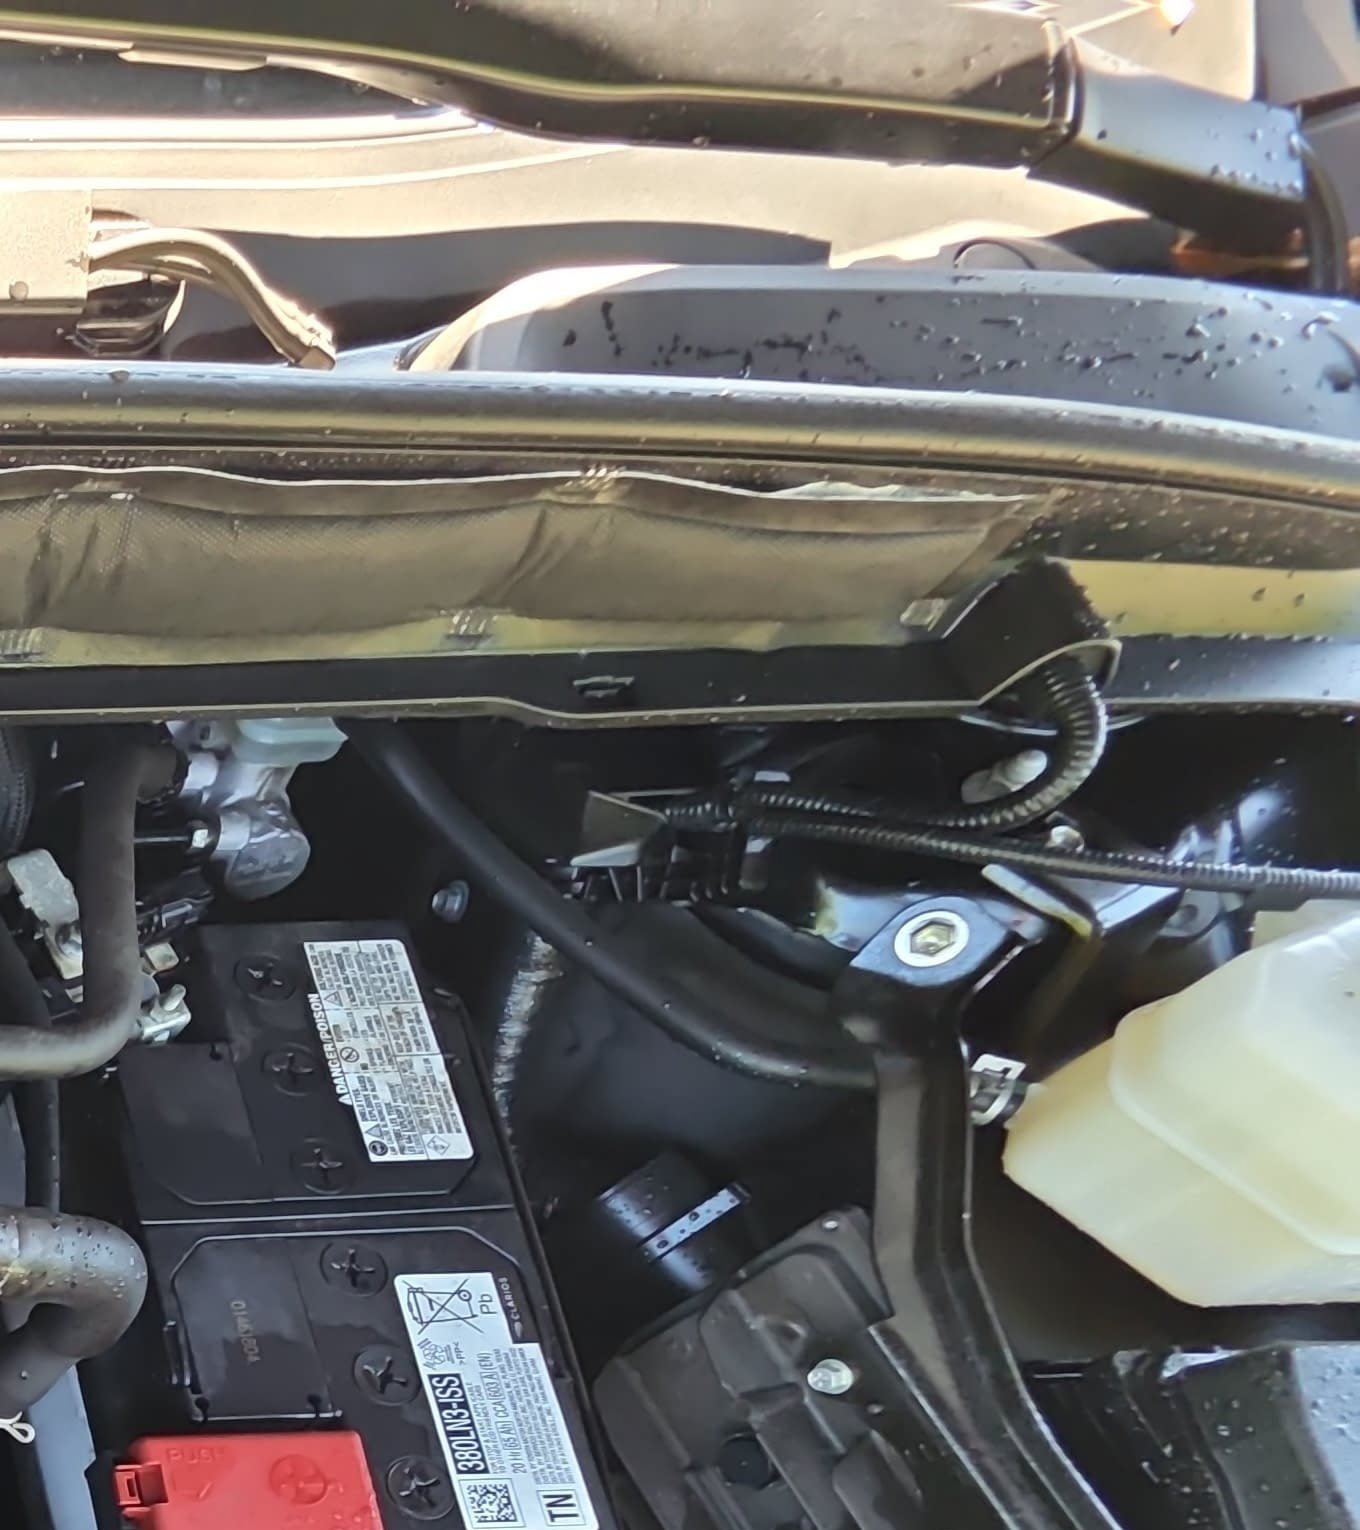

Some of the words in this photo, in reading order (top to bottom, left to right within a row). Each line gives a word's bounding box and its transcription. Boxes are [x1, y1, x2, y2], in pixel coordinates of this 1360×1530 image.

[307, 993, 348, 1095] DANGER/POISON
[475, 1293, 496, 1314] Pb
[498, 1276, 521, 1319] CLARIOS
[476, 1352, 495, 1370] (EN)
[485, 1382, 504, 1397] 603
[490, 1400, 510, 1417] CCA
[431, 1375, 486, 1471] 380LN3-ISS
[498, 1423, 515, 1434] Ah
[502, 1437, 519, 1447] 65
[510, 1462, 527, 1473] 20
[542, 1494, 581, 1522] TN
